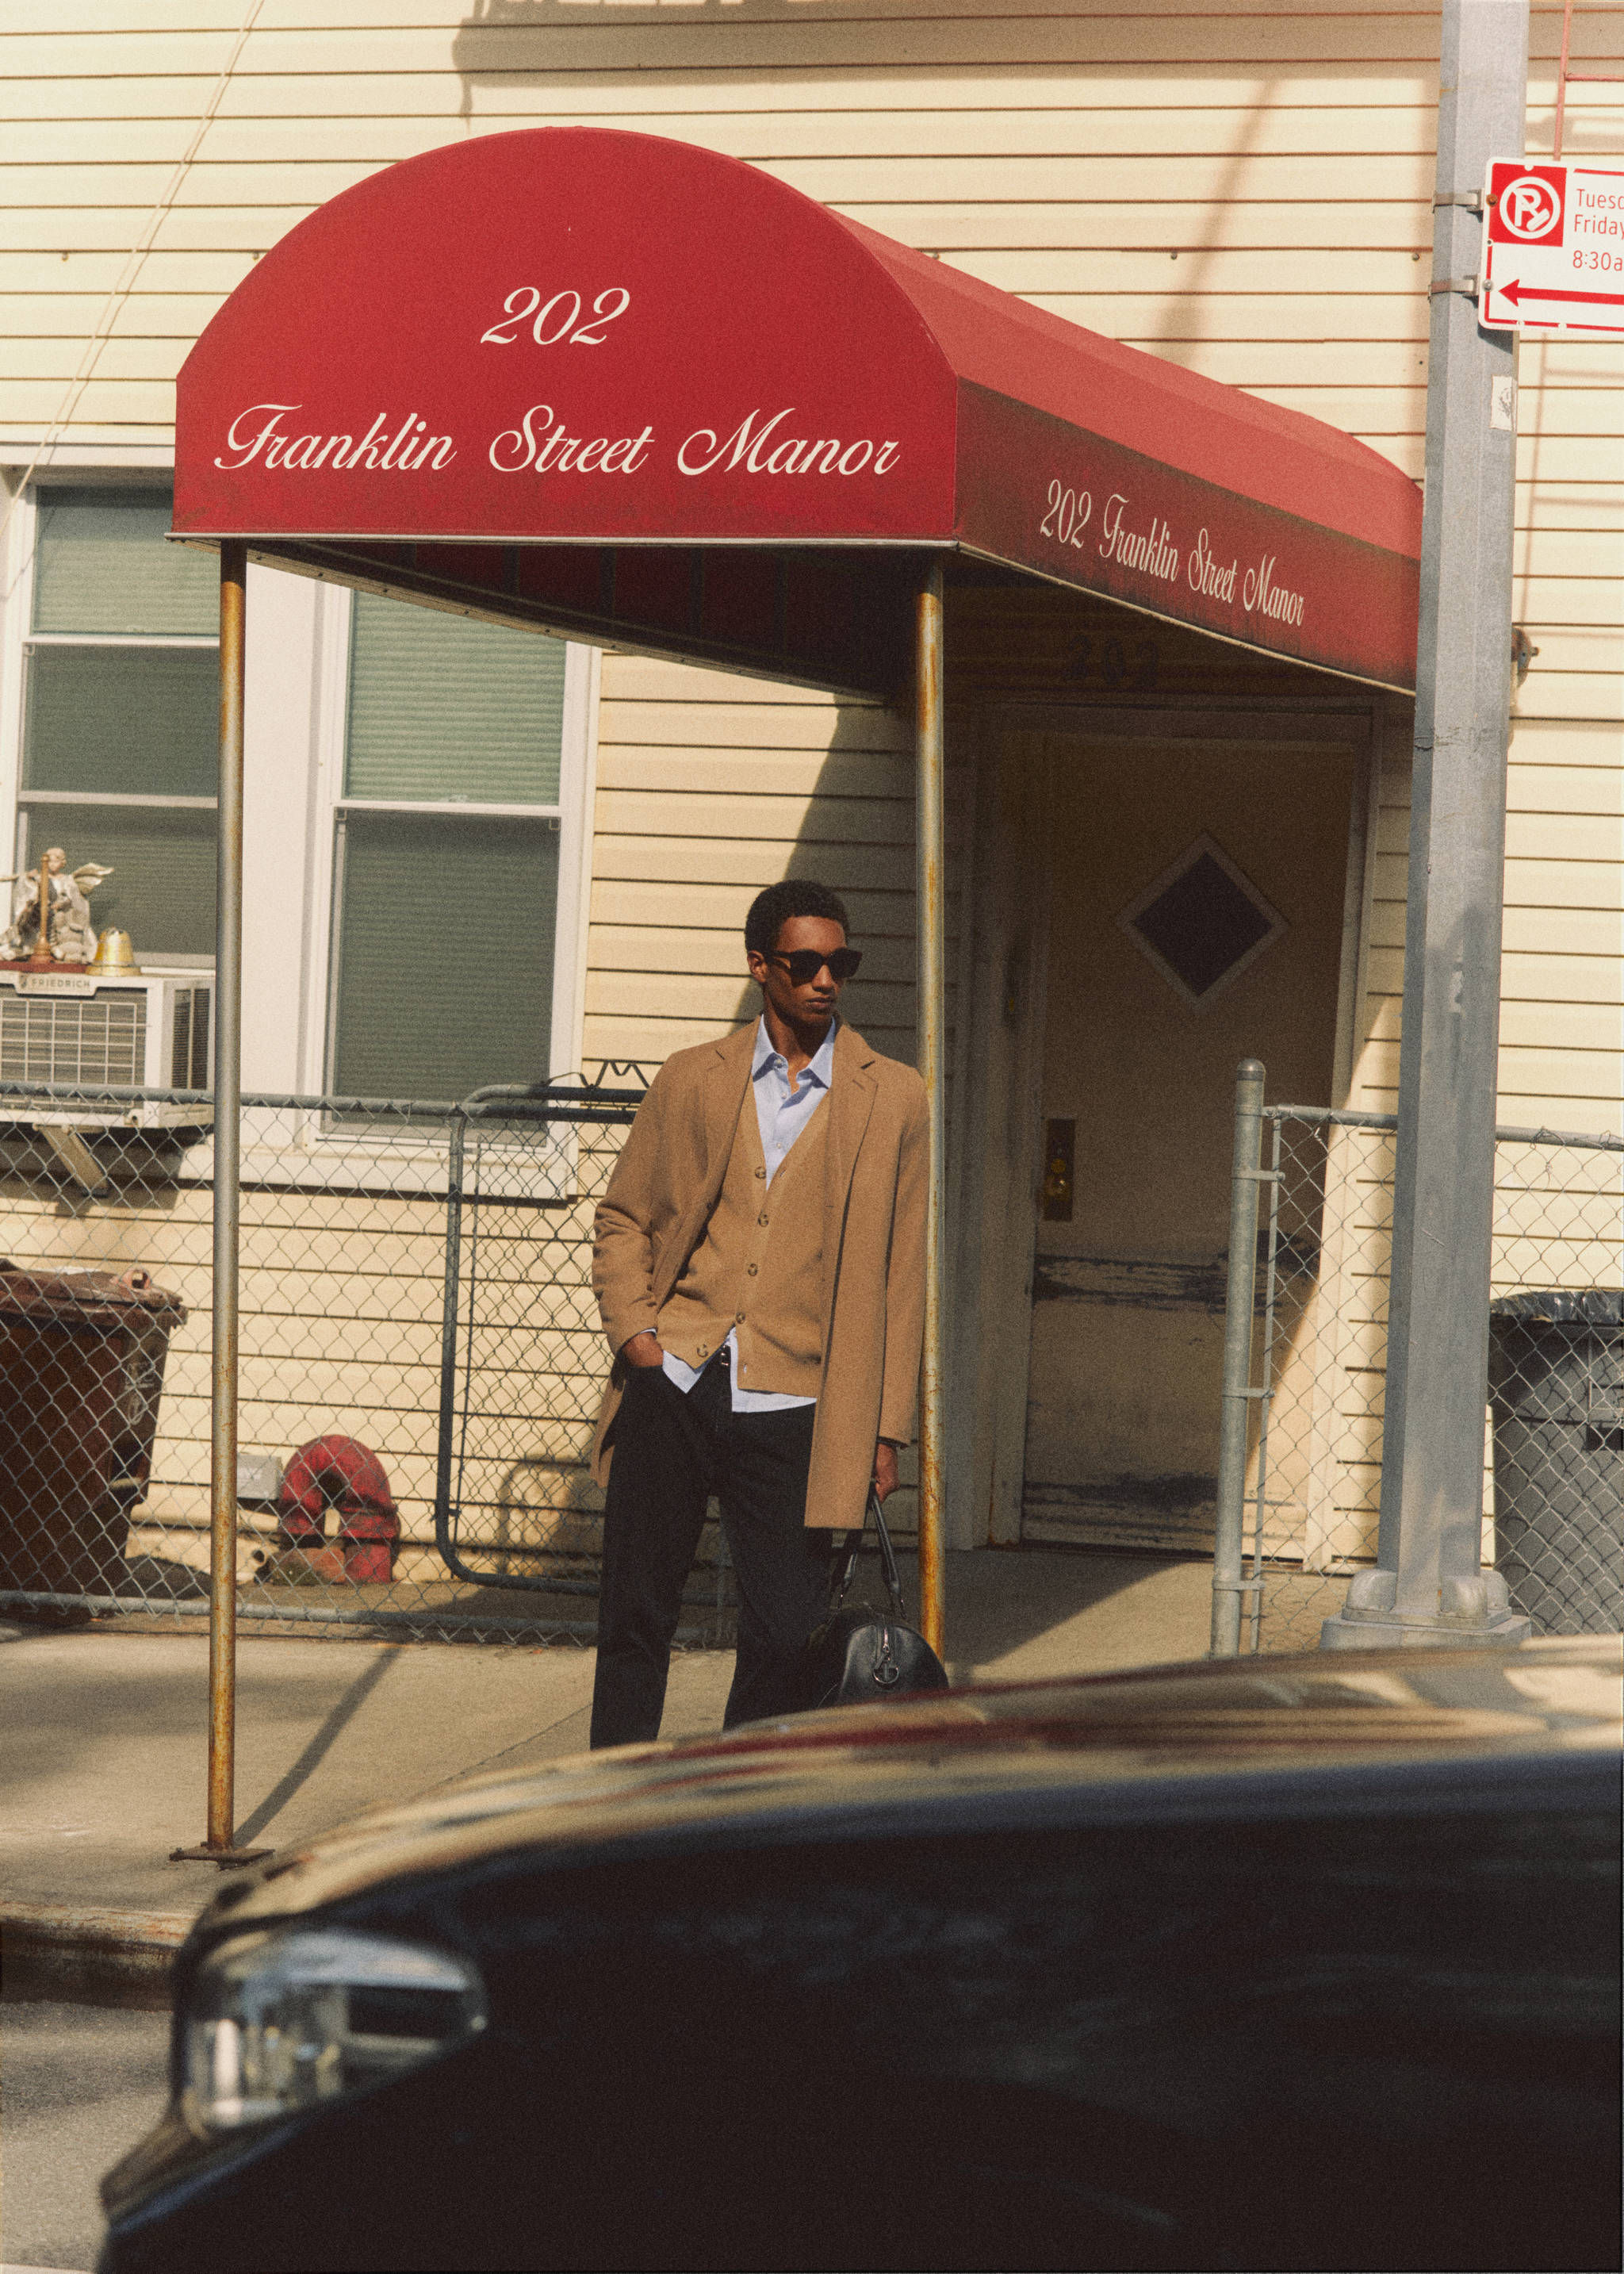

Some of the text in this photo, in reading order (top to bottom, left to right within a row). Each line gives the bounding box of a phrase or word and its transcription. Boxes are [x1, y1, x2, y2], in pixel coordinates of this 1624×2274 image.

[479, 286, 631, 346] 202
[213, 402, 902, 476] Franklin Street Manor
[1040, 477, 1305, 627] 202 Franklin Street Manor
[31, 977, 90, 989] FRIEDRICH
